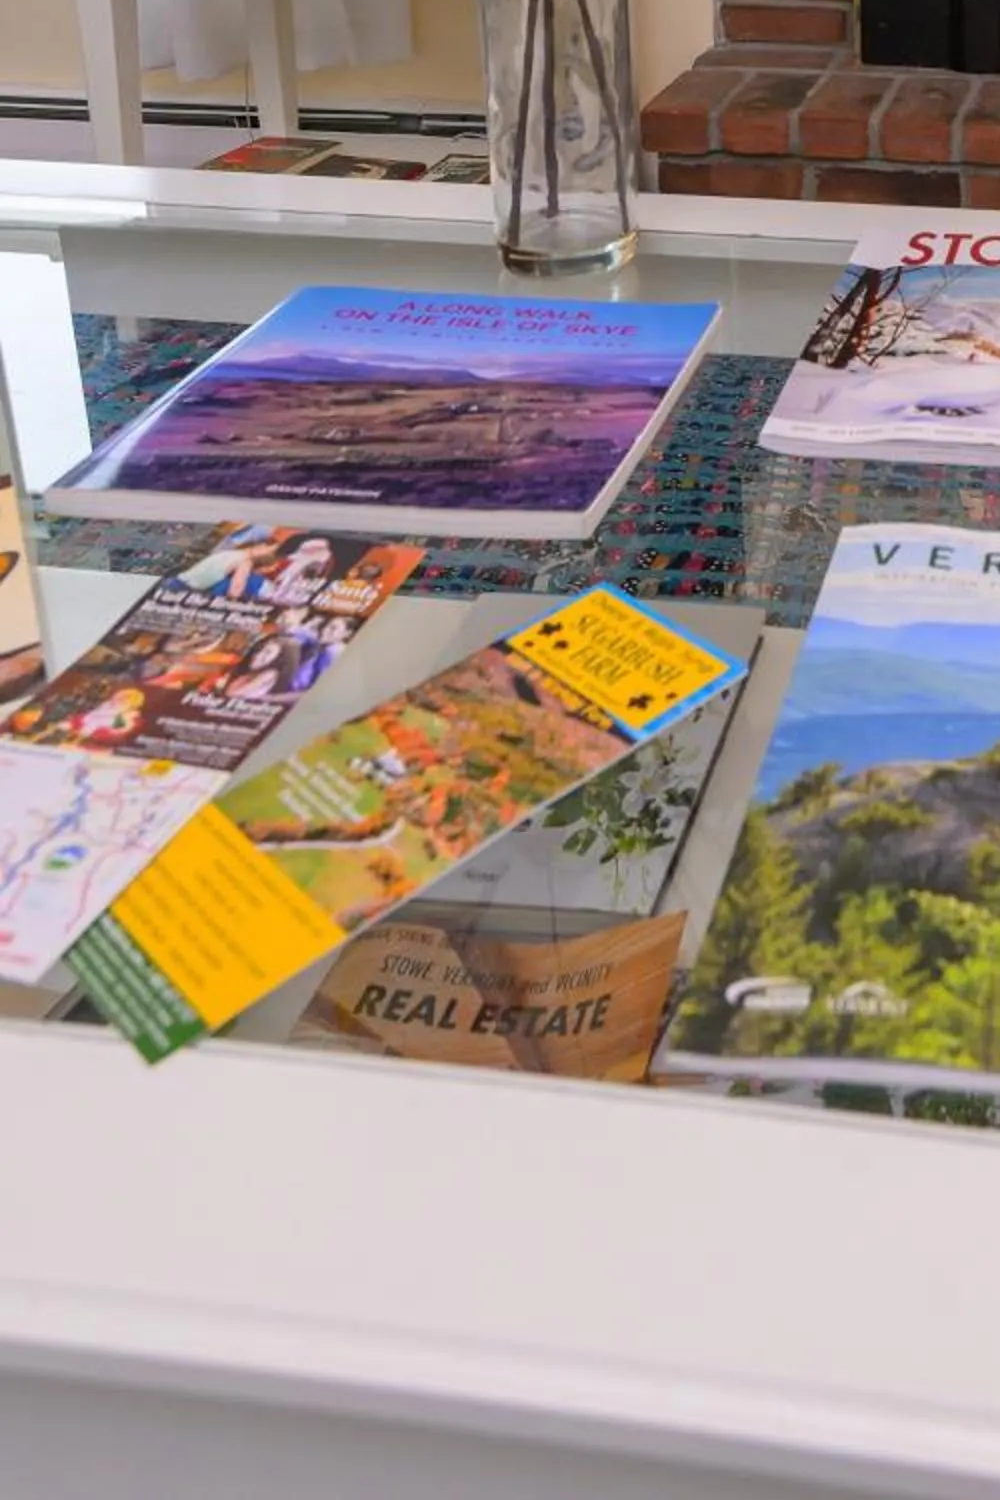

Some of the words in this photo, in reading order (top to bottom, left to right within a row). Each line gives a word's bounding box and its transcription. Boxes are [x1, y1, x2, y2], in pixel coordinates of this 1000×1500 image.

[334, 308, 379, 321] ON
[387, 312, 441, 327] THE
[447, 316, 509, 330] ISLE
[517, 320, 558, 332] OF
[564, 324, 640, 337] SKYE
[514, 309, 594, 321] WALK
[352, 984, 459, 1030] REAL
[470, 994, 612, 1037] ESTATE
